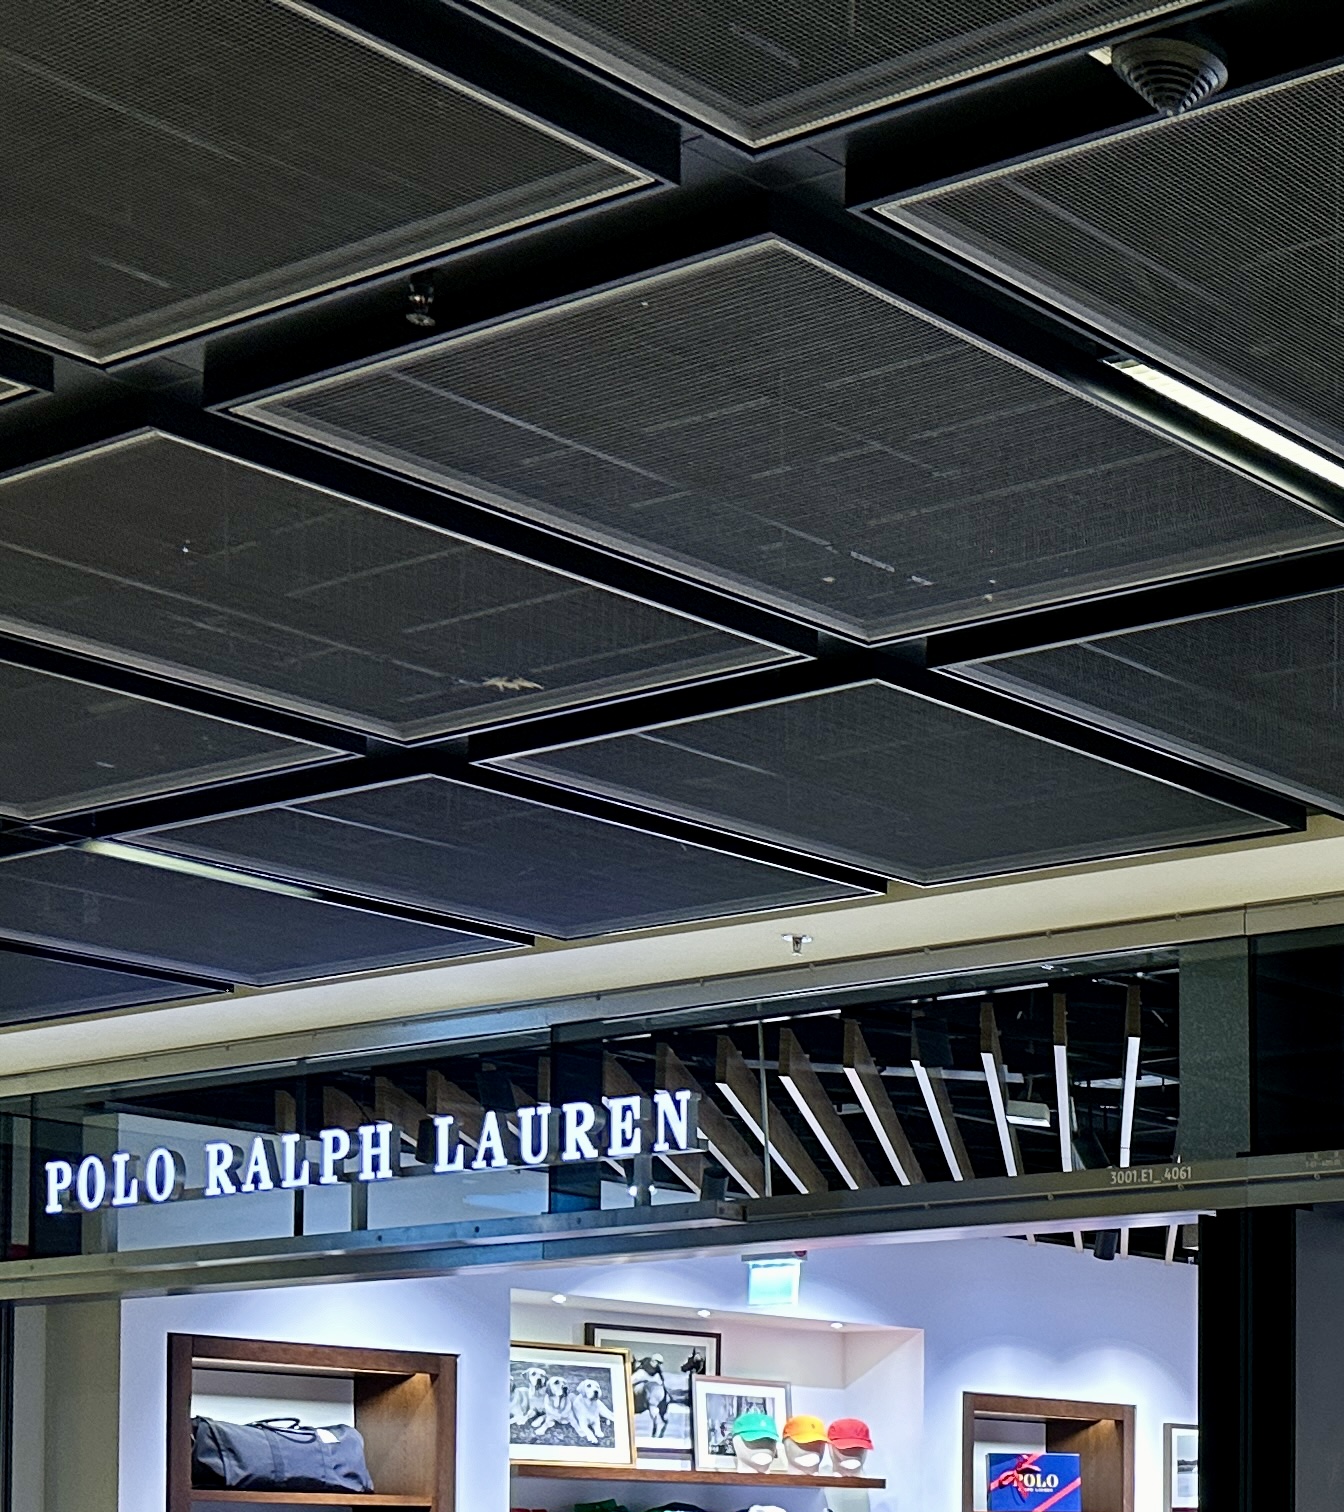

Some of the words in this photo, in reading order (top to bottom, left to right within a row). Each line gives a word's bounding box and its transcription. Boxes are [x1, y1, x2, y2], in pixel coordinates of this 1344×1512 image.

[45, 1148, 175, 1214] POLO
[205, 1122, 392, 1196] RALPH
[433, 1090, 691, 1173] LAUREN
